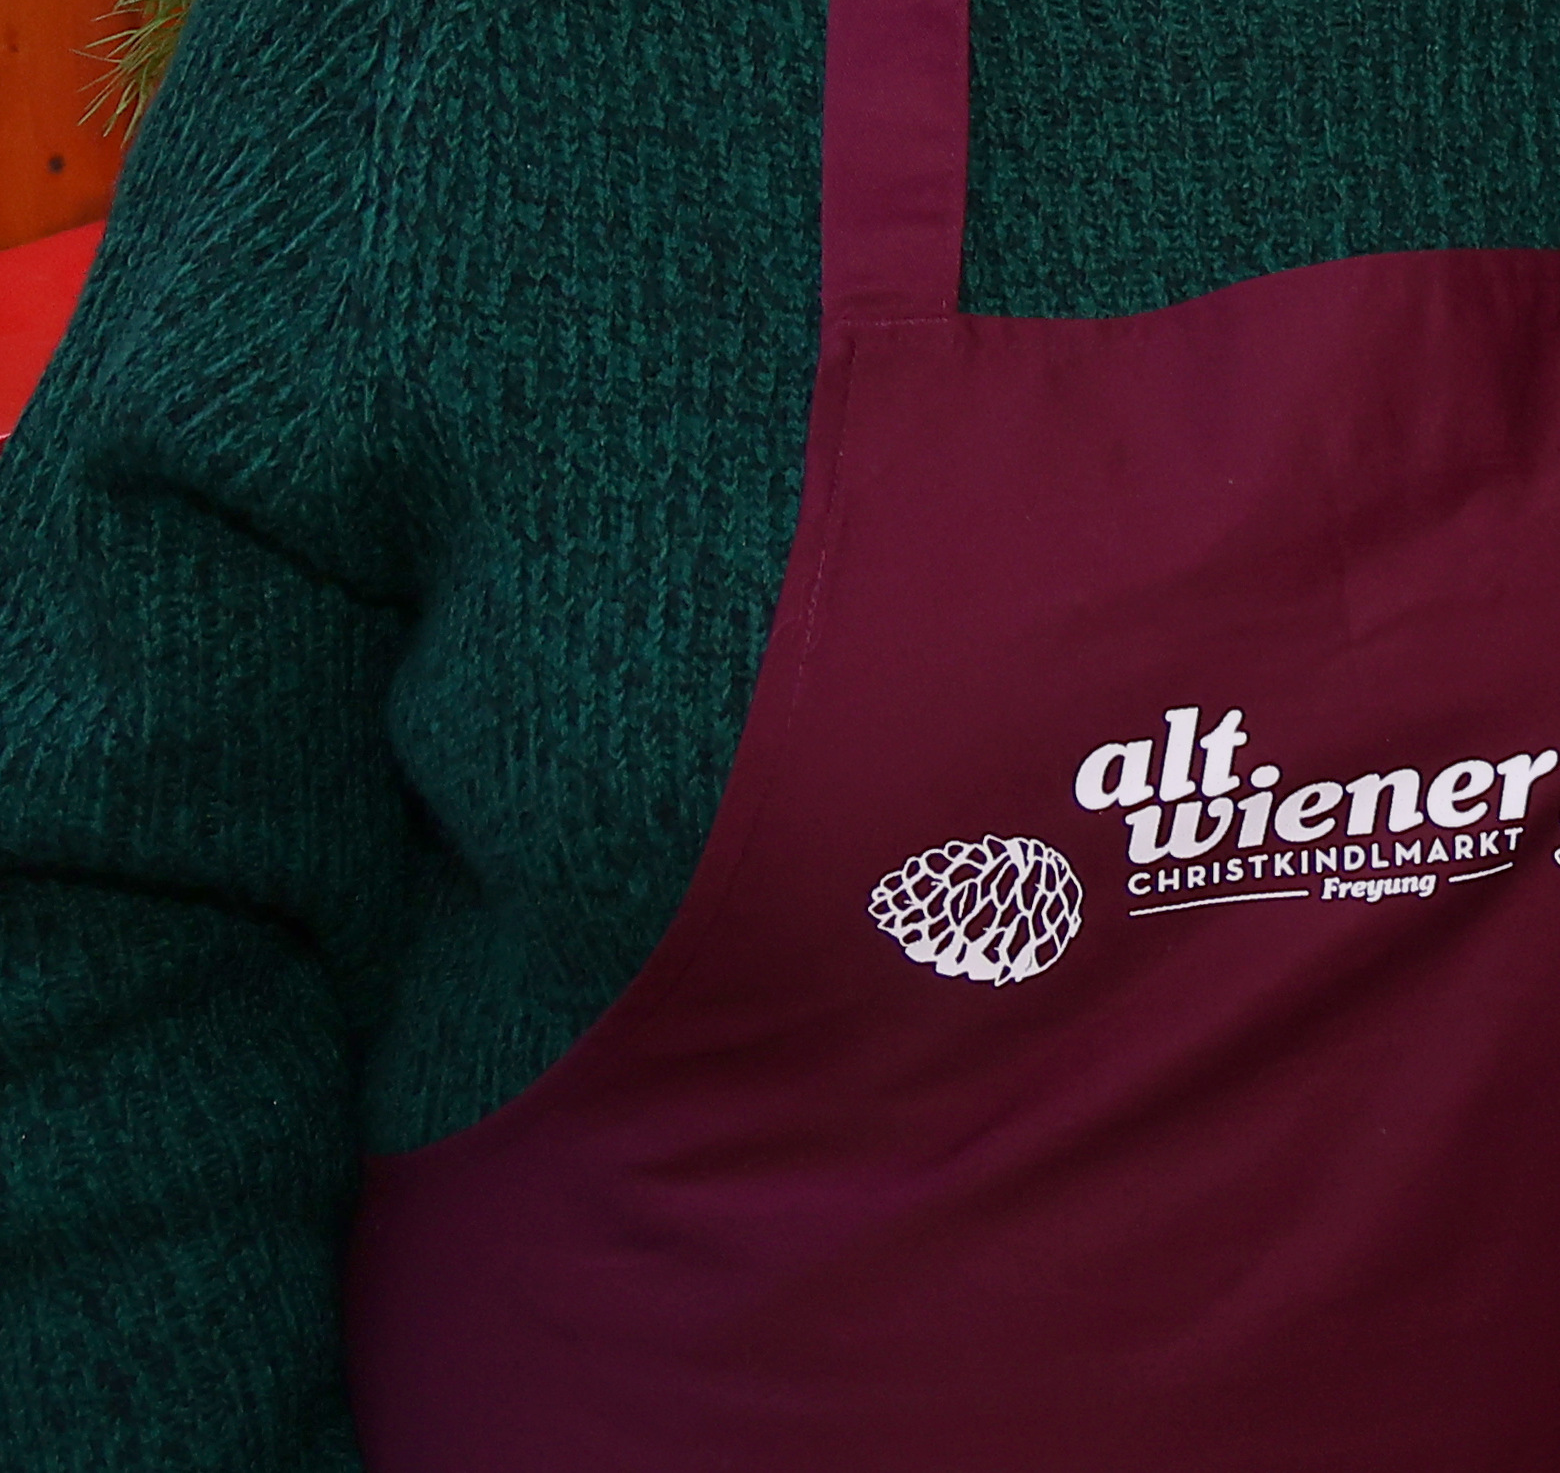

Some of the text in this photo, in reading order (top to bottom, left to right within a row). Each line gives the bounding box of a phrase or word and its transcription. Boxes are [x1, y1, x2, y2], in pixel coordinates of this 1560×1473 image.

[1074, 706, 1250, 812] alt
[1123, 749, 1559, 865] wiener
[1127, 826, 1525, 897] CHRISTKINDLMARKT
[1320, 872, 1437, 904] Freyung
